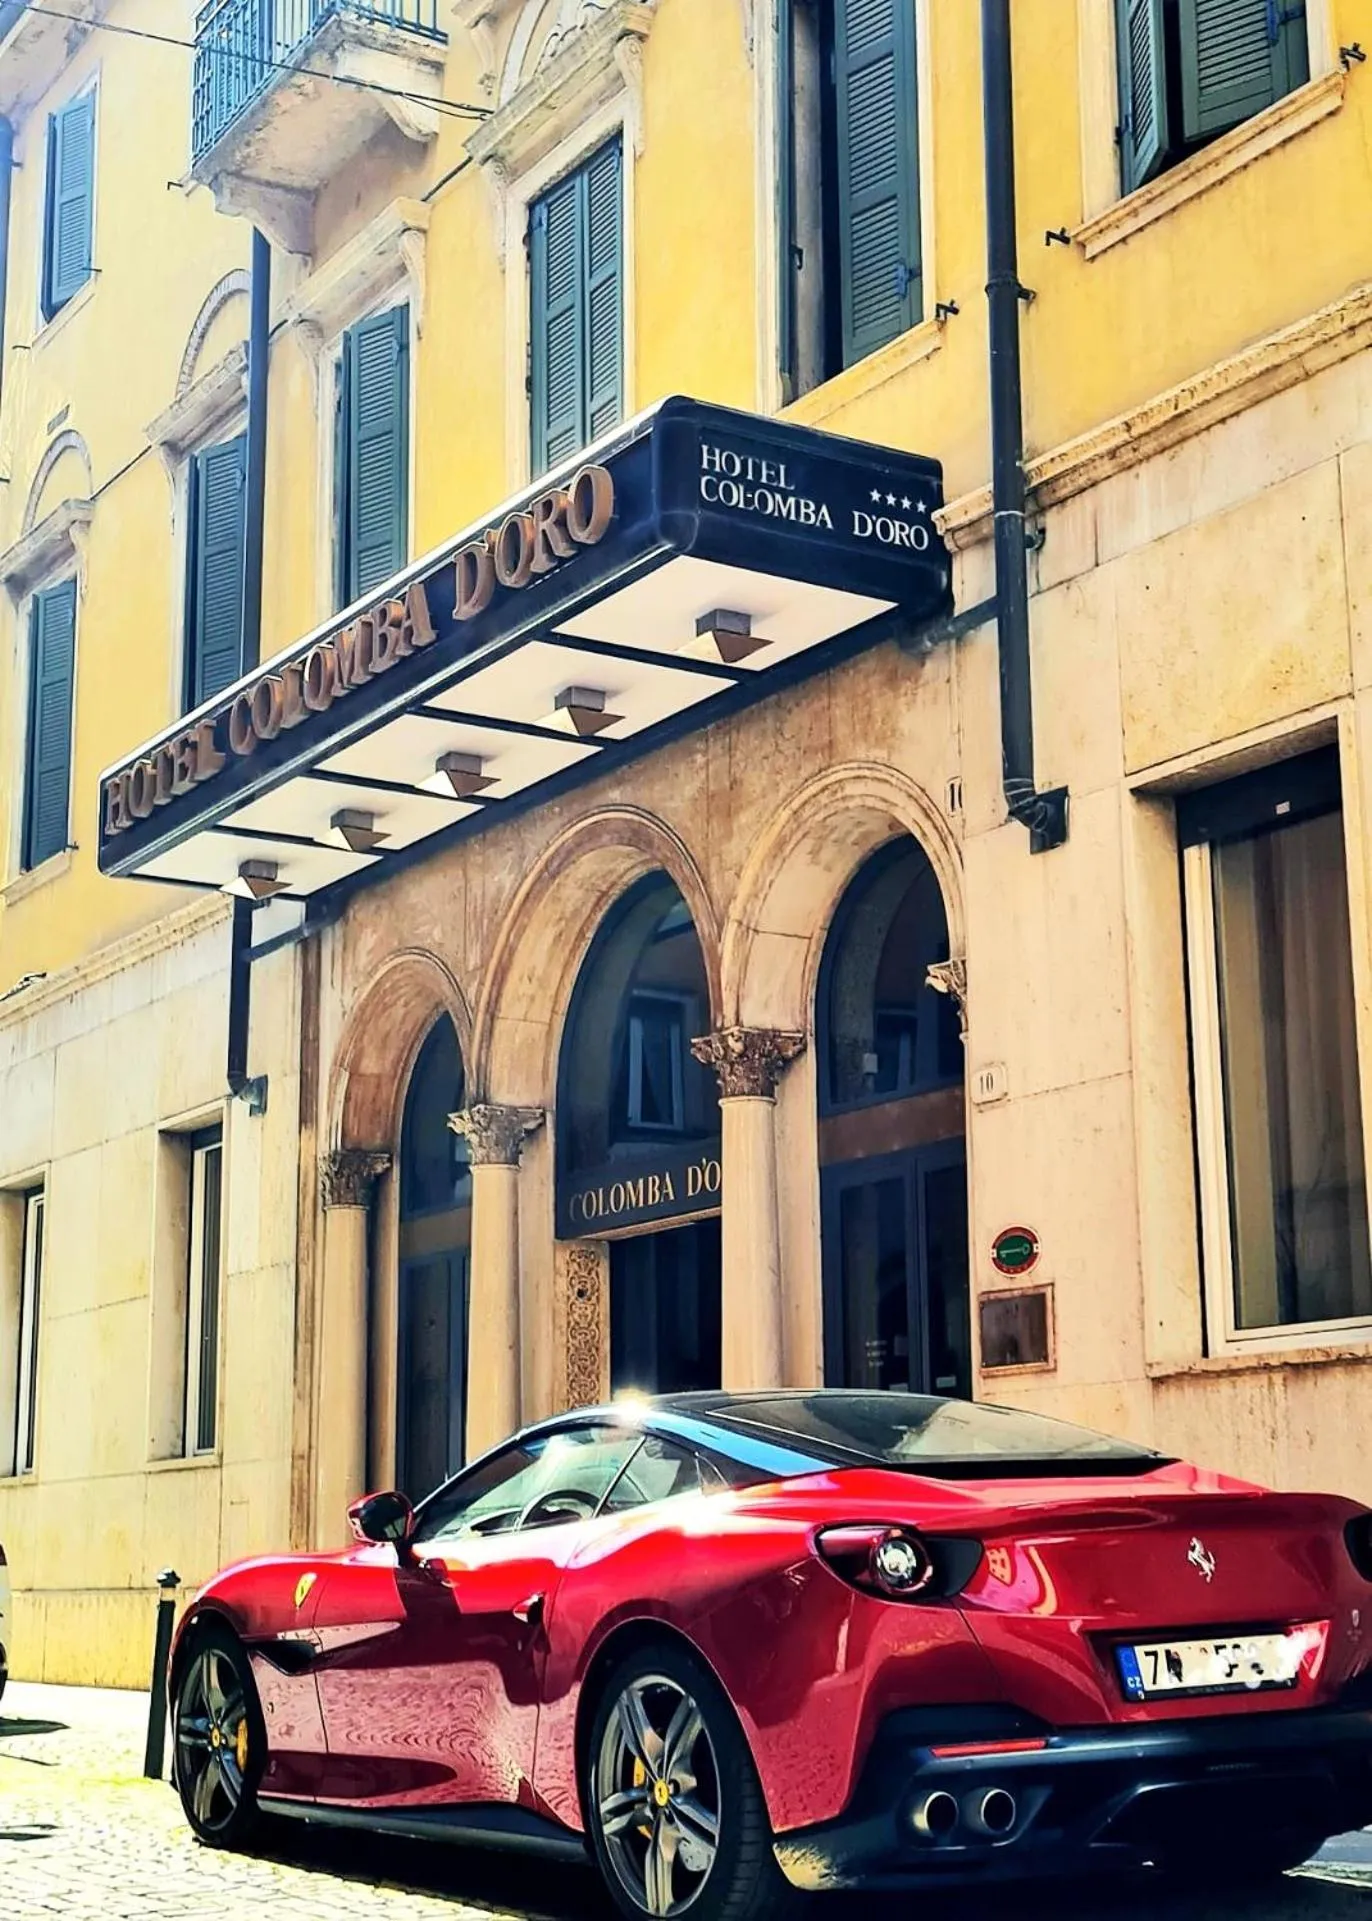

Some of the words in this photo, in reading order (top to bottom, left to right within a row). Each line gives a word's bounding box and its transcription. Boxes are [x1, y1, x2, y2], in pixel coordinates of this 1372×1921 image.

[701, 445, 796, 490] HOTEL
[700, 475, 834, 529] COLOMBA
[852, 511, 929, 550] D'ORO
[104, 719, 226, 835] HOTEL
[230, 583, 437, 755] COLOMBA
[452, 464, 614, 621] D'ORO
[980, 1072, 994, 1096] 10
[570, 1171, 675, 1222] COLOMBA
[1127, 1676, 1142, 1688] CZ
